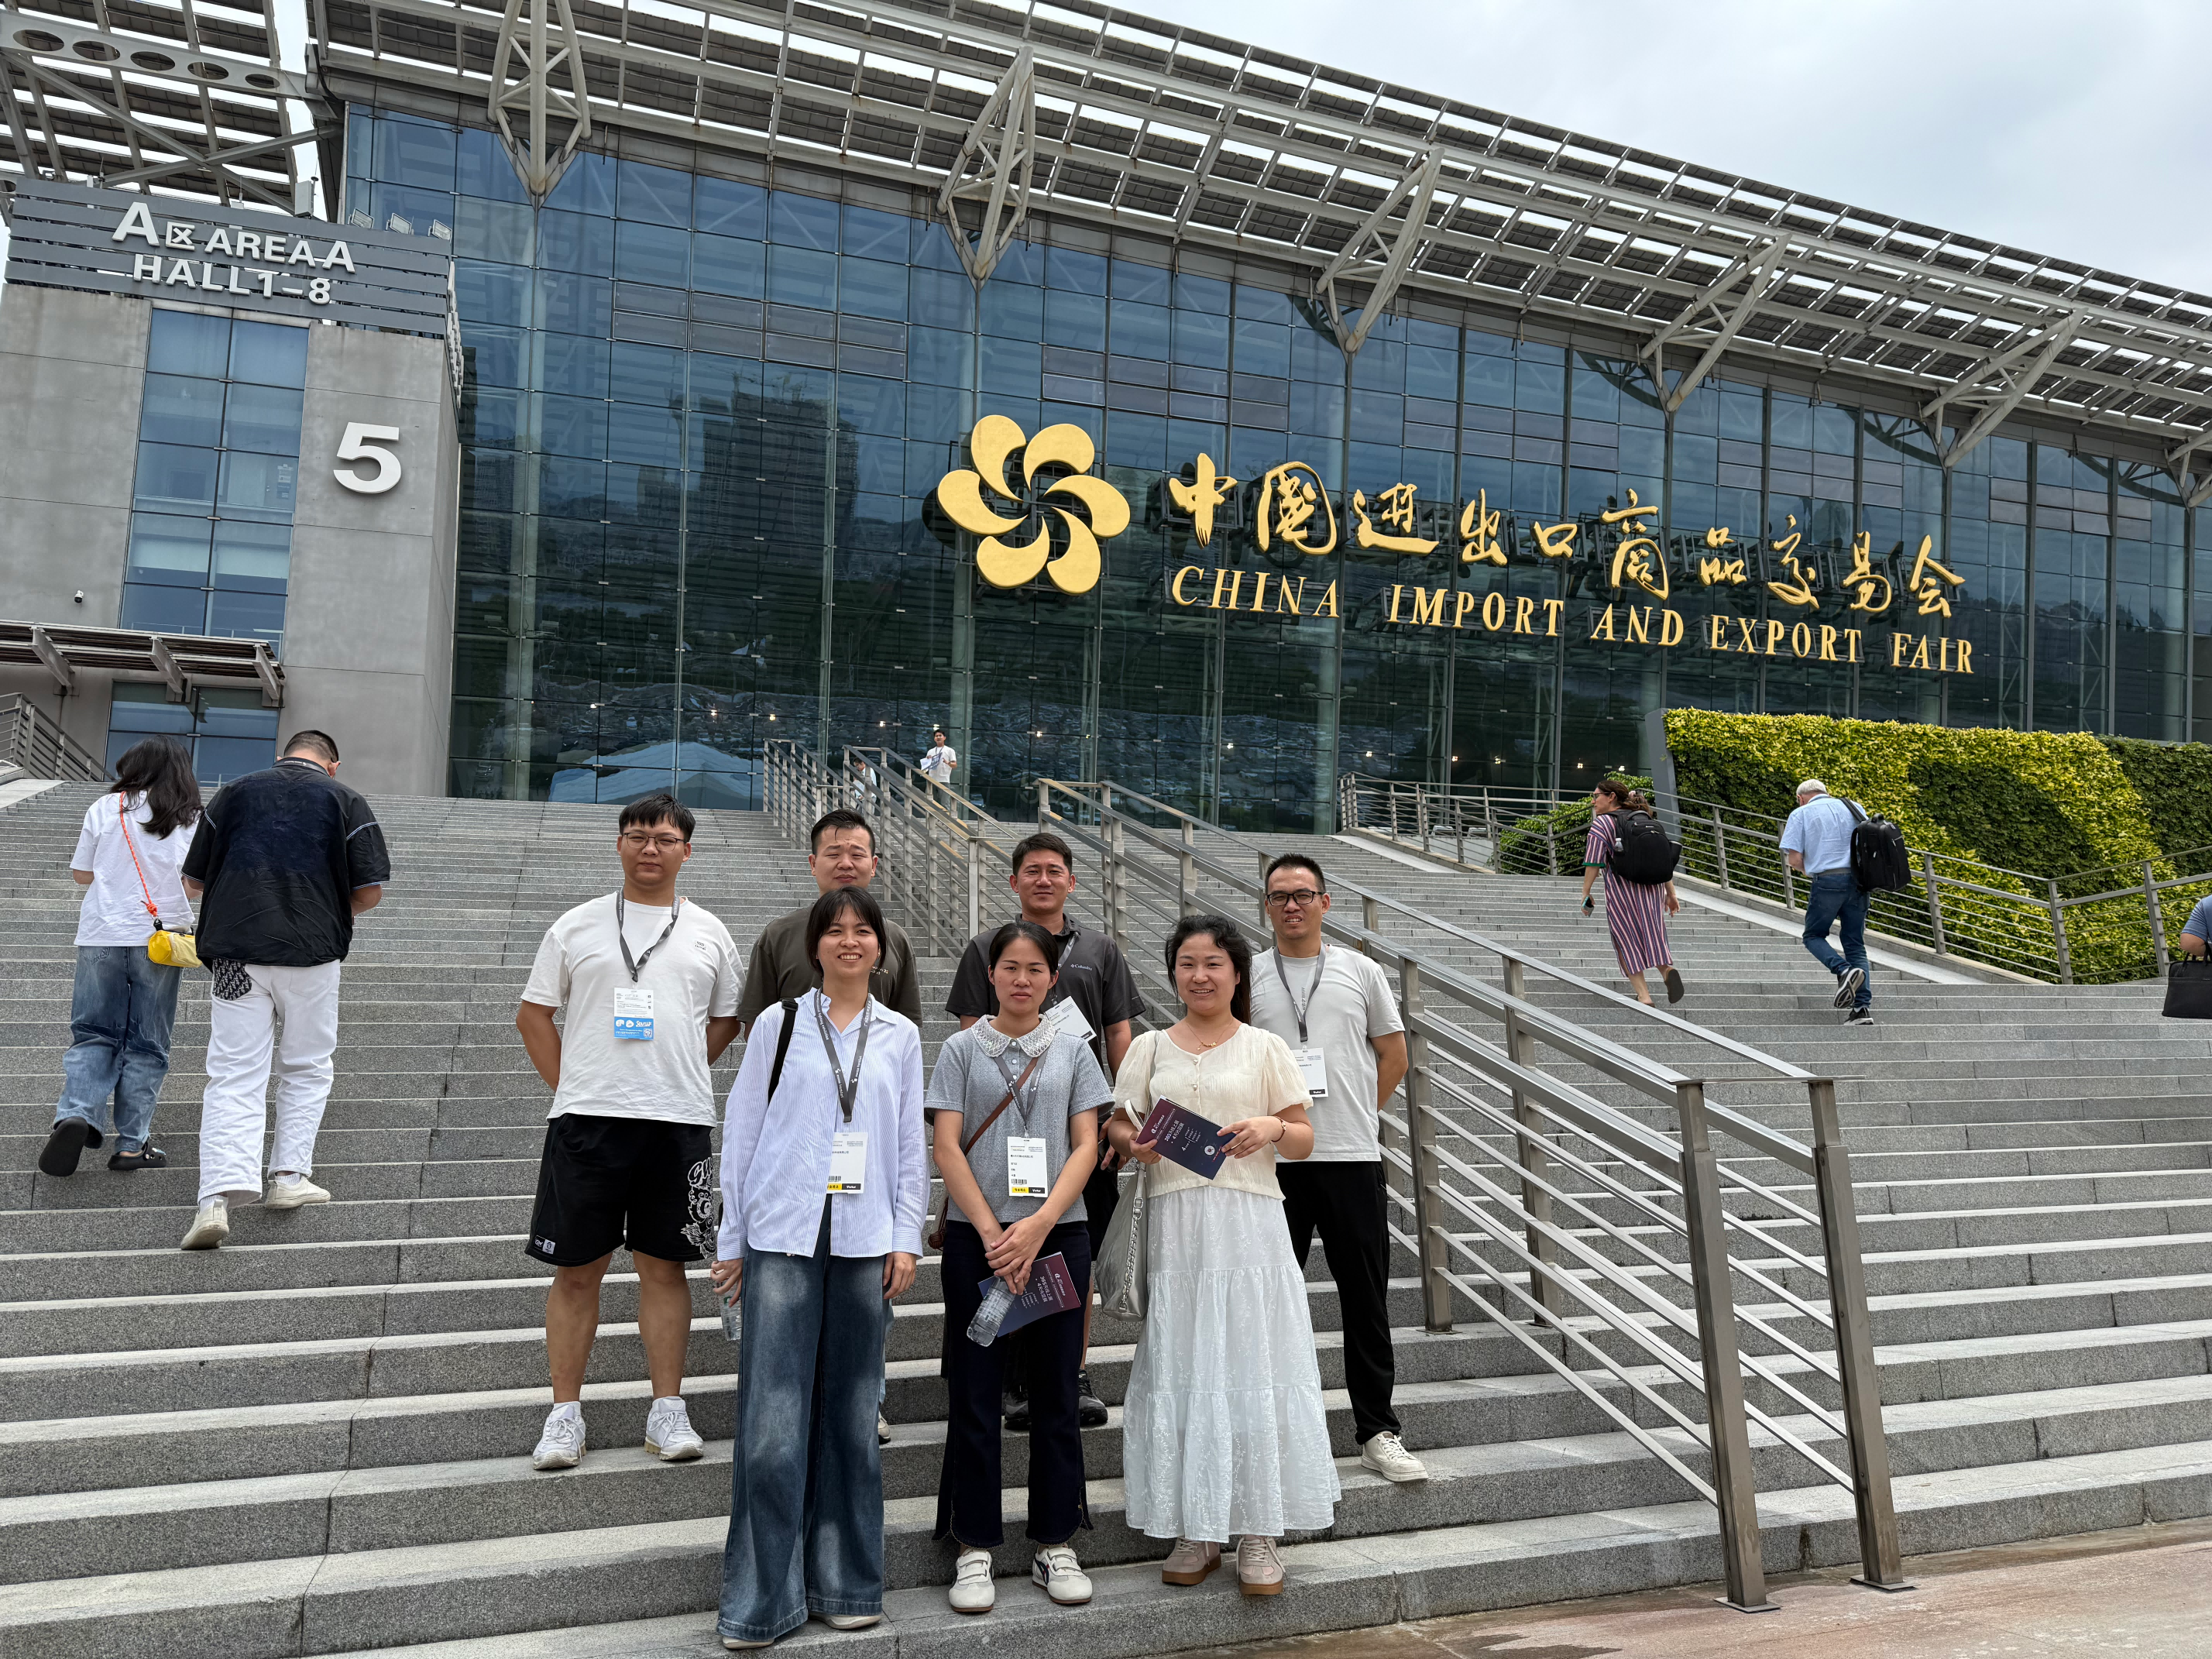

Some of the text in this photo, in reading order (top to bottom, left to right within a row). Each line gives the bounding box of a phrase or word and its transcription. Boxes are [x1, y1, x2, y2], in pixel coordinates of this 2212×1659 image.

[204, 227, 316, 268] AREA
[333, 421, 402, 494] 5
[1171, 565, 1974, 674] CHINA IMPORT AND EXPORT FAIR
